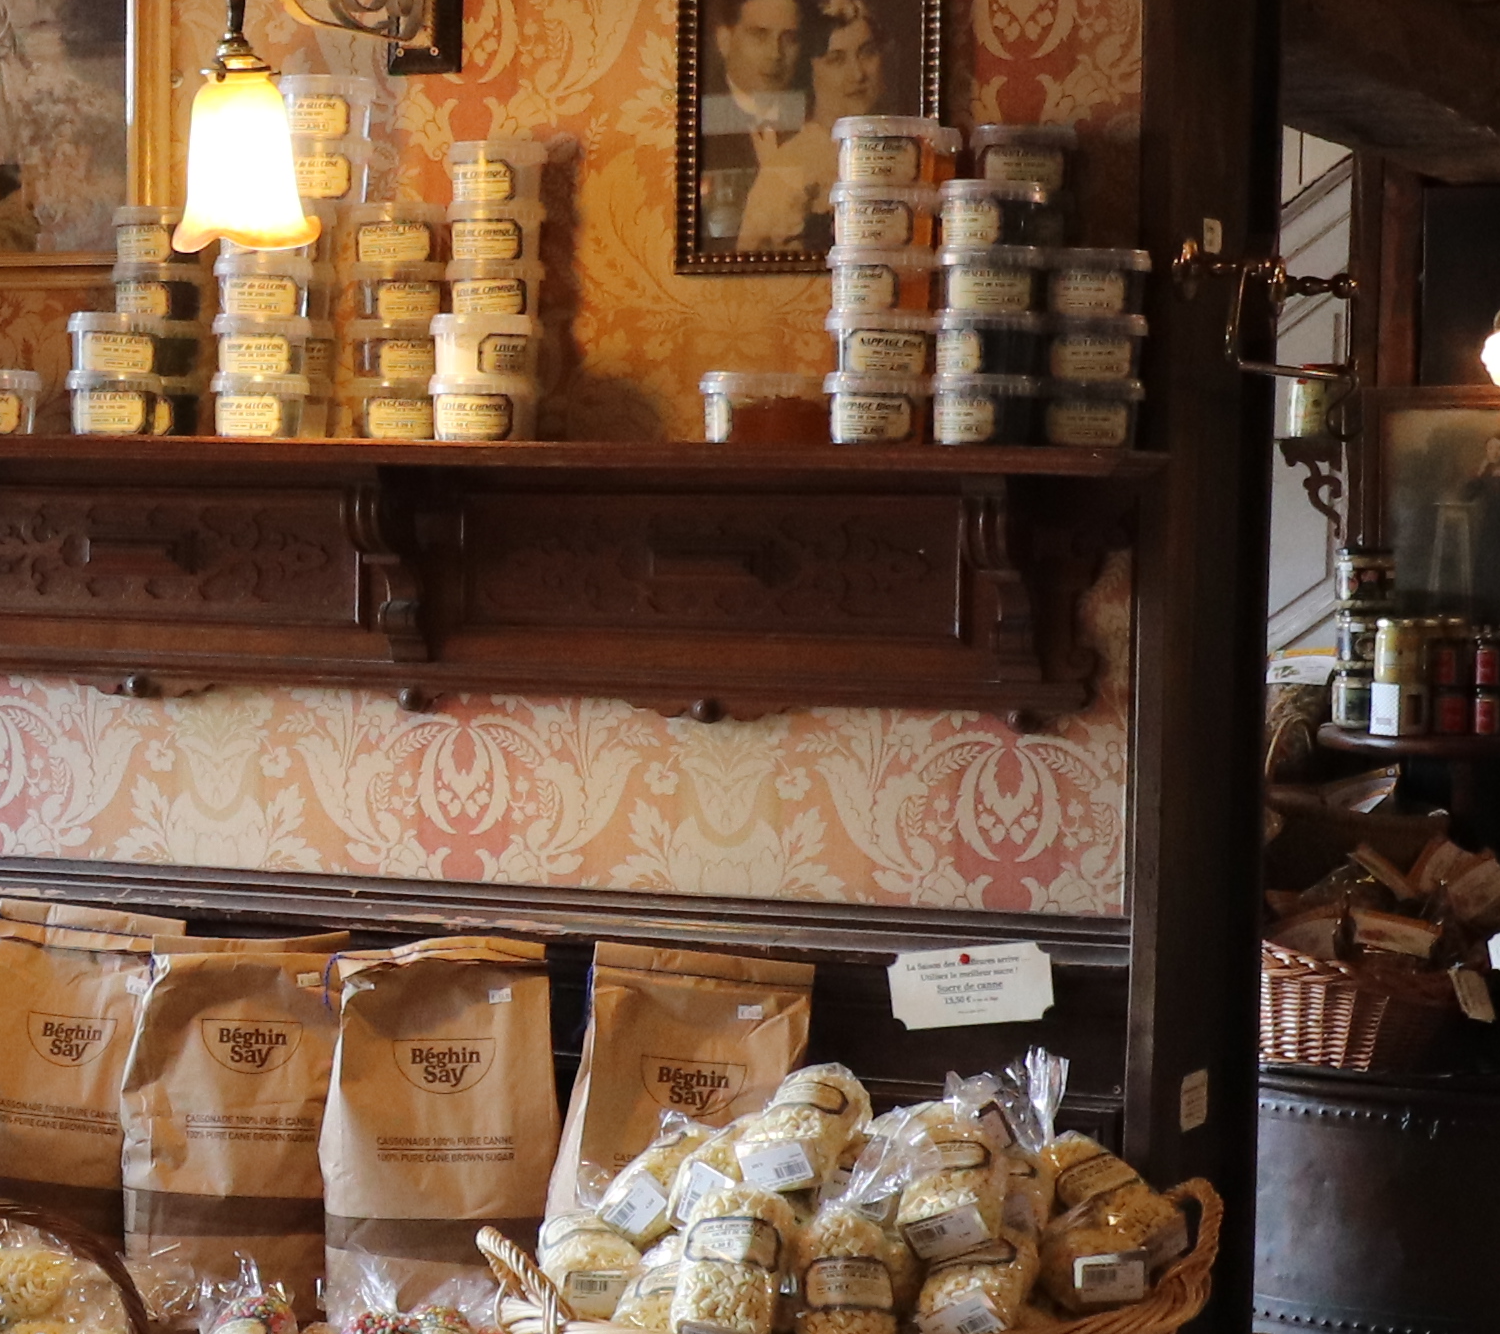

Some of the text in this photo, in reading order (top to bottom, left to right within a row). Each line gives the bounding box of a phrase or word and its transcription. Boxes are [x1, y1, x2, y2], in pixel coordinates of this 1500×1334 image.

[937, 980, 1004, 994] Sucre de canne
[41, 1020, 103, 1046] Béghin
[218, 1026, 288, 1049] Béghin
[49, 1038, 88, 1062] Say
[229, 1043, 273, 1068] Say
[411, 1047, 481, 1069] Béghin
[423, 1063, 468, 1087] Say
[657, 1066, 730, 1091] Béghin
[668, 1084, 717, 1109] Say
